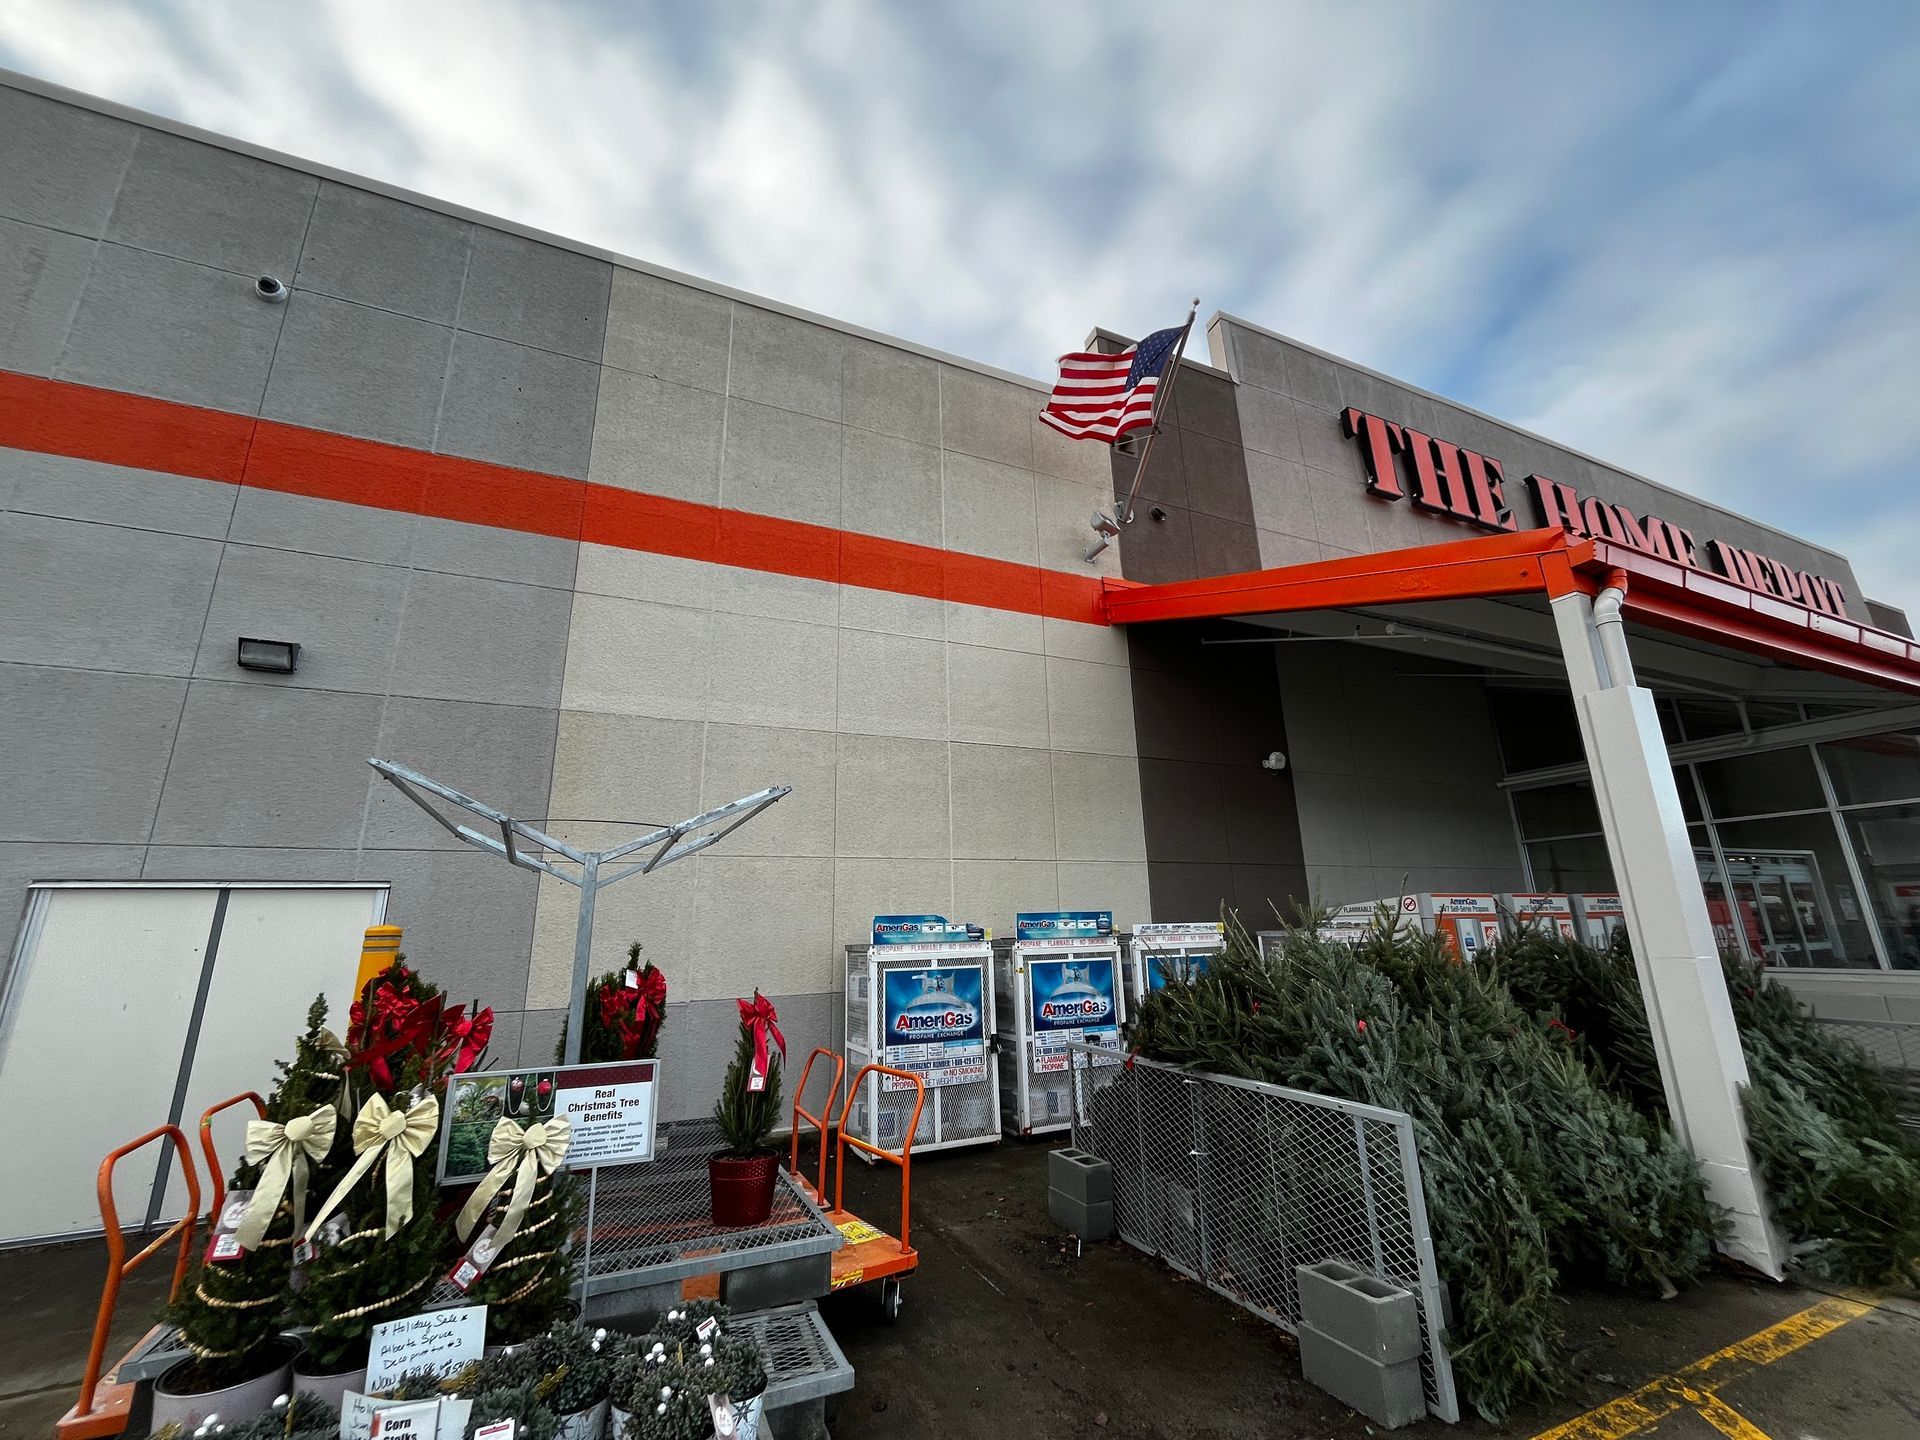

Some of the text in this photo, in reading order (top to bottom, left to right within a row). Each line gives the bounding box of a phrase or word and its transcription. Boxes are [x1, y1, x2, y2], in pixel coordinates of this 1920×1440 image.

[1340, 406, 1847, 618] THE HOME DEPOT
[876, 923, 919, 933] AmeriGas
[1019, 920, 1056, 929] AmeriGas
[1042, 1000, 1107, 1017] AmeriGas
[895, 1011, 973, 1030] AmeriGas
[909, 1030, 964, 1040] PROPANE EXCHANGE
[906, 1062, 932, 1070] EMERGENCY
[948, 1069, 958, 1077] NO
[958, 1066, 984, 1076] SMOKING
[1041, 1063, 1065, 1071] PROPANE
[891, 1081, 917, 1090] PROPAN
[595, 1088, 616, 1099] Real
[567, 1098, 640, 1113] Christmas Tree
[583, 1110, 623, 1122] Benefits
[393, 1314, 457, 1336] Holiday Sale
[381, 1330, 454, 1357] Alberta Spruce
[385, 1418, 412, 1432] Corn
